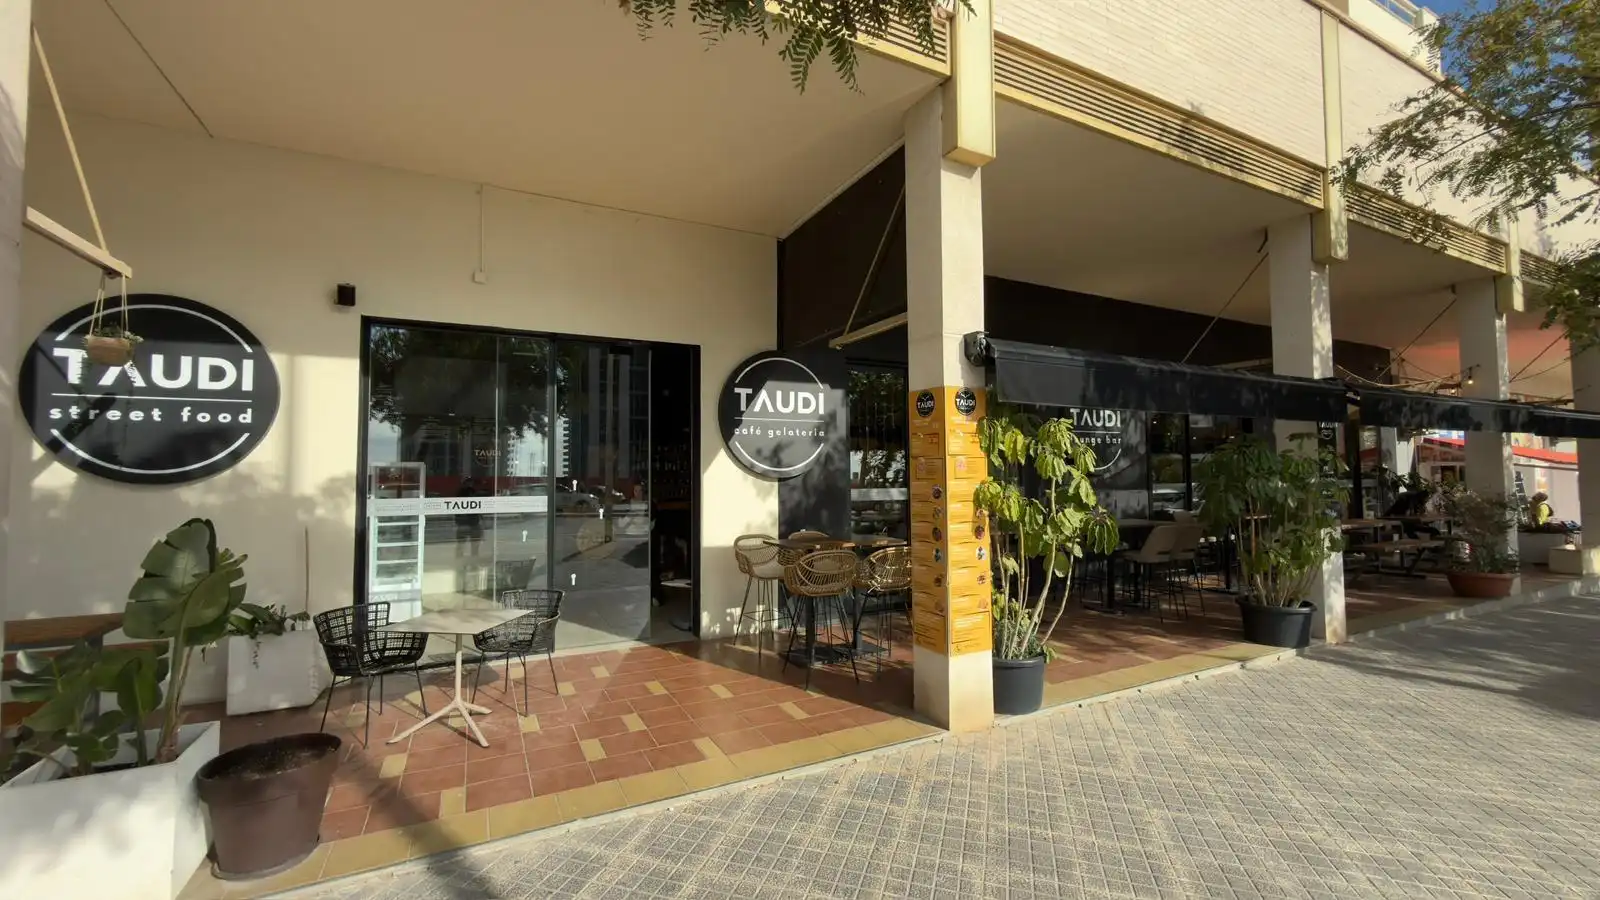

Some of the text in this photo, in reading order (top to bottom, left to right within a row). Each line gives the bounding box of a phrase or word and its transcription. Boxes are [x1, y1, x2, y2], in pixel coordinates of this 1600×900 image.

[52, 347, 254, 392] TAUDI
[734, 387, 825, 415] TAUDI
[956, 398, 976, 406] TAUDI
[49, 405, 253, 424] street food
[1069, 408, 1121, 427] TAUDI
[734, 425, 825, 438] café gelateria
[1105, 434, 1121, 444] bar
[443, 500, 482, 510] TAUDI
